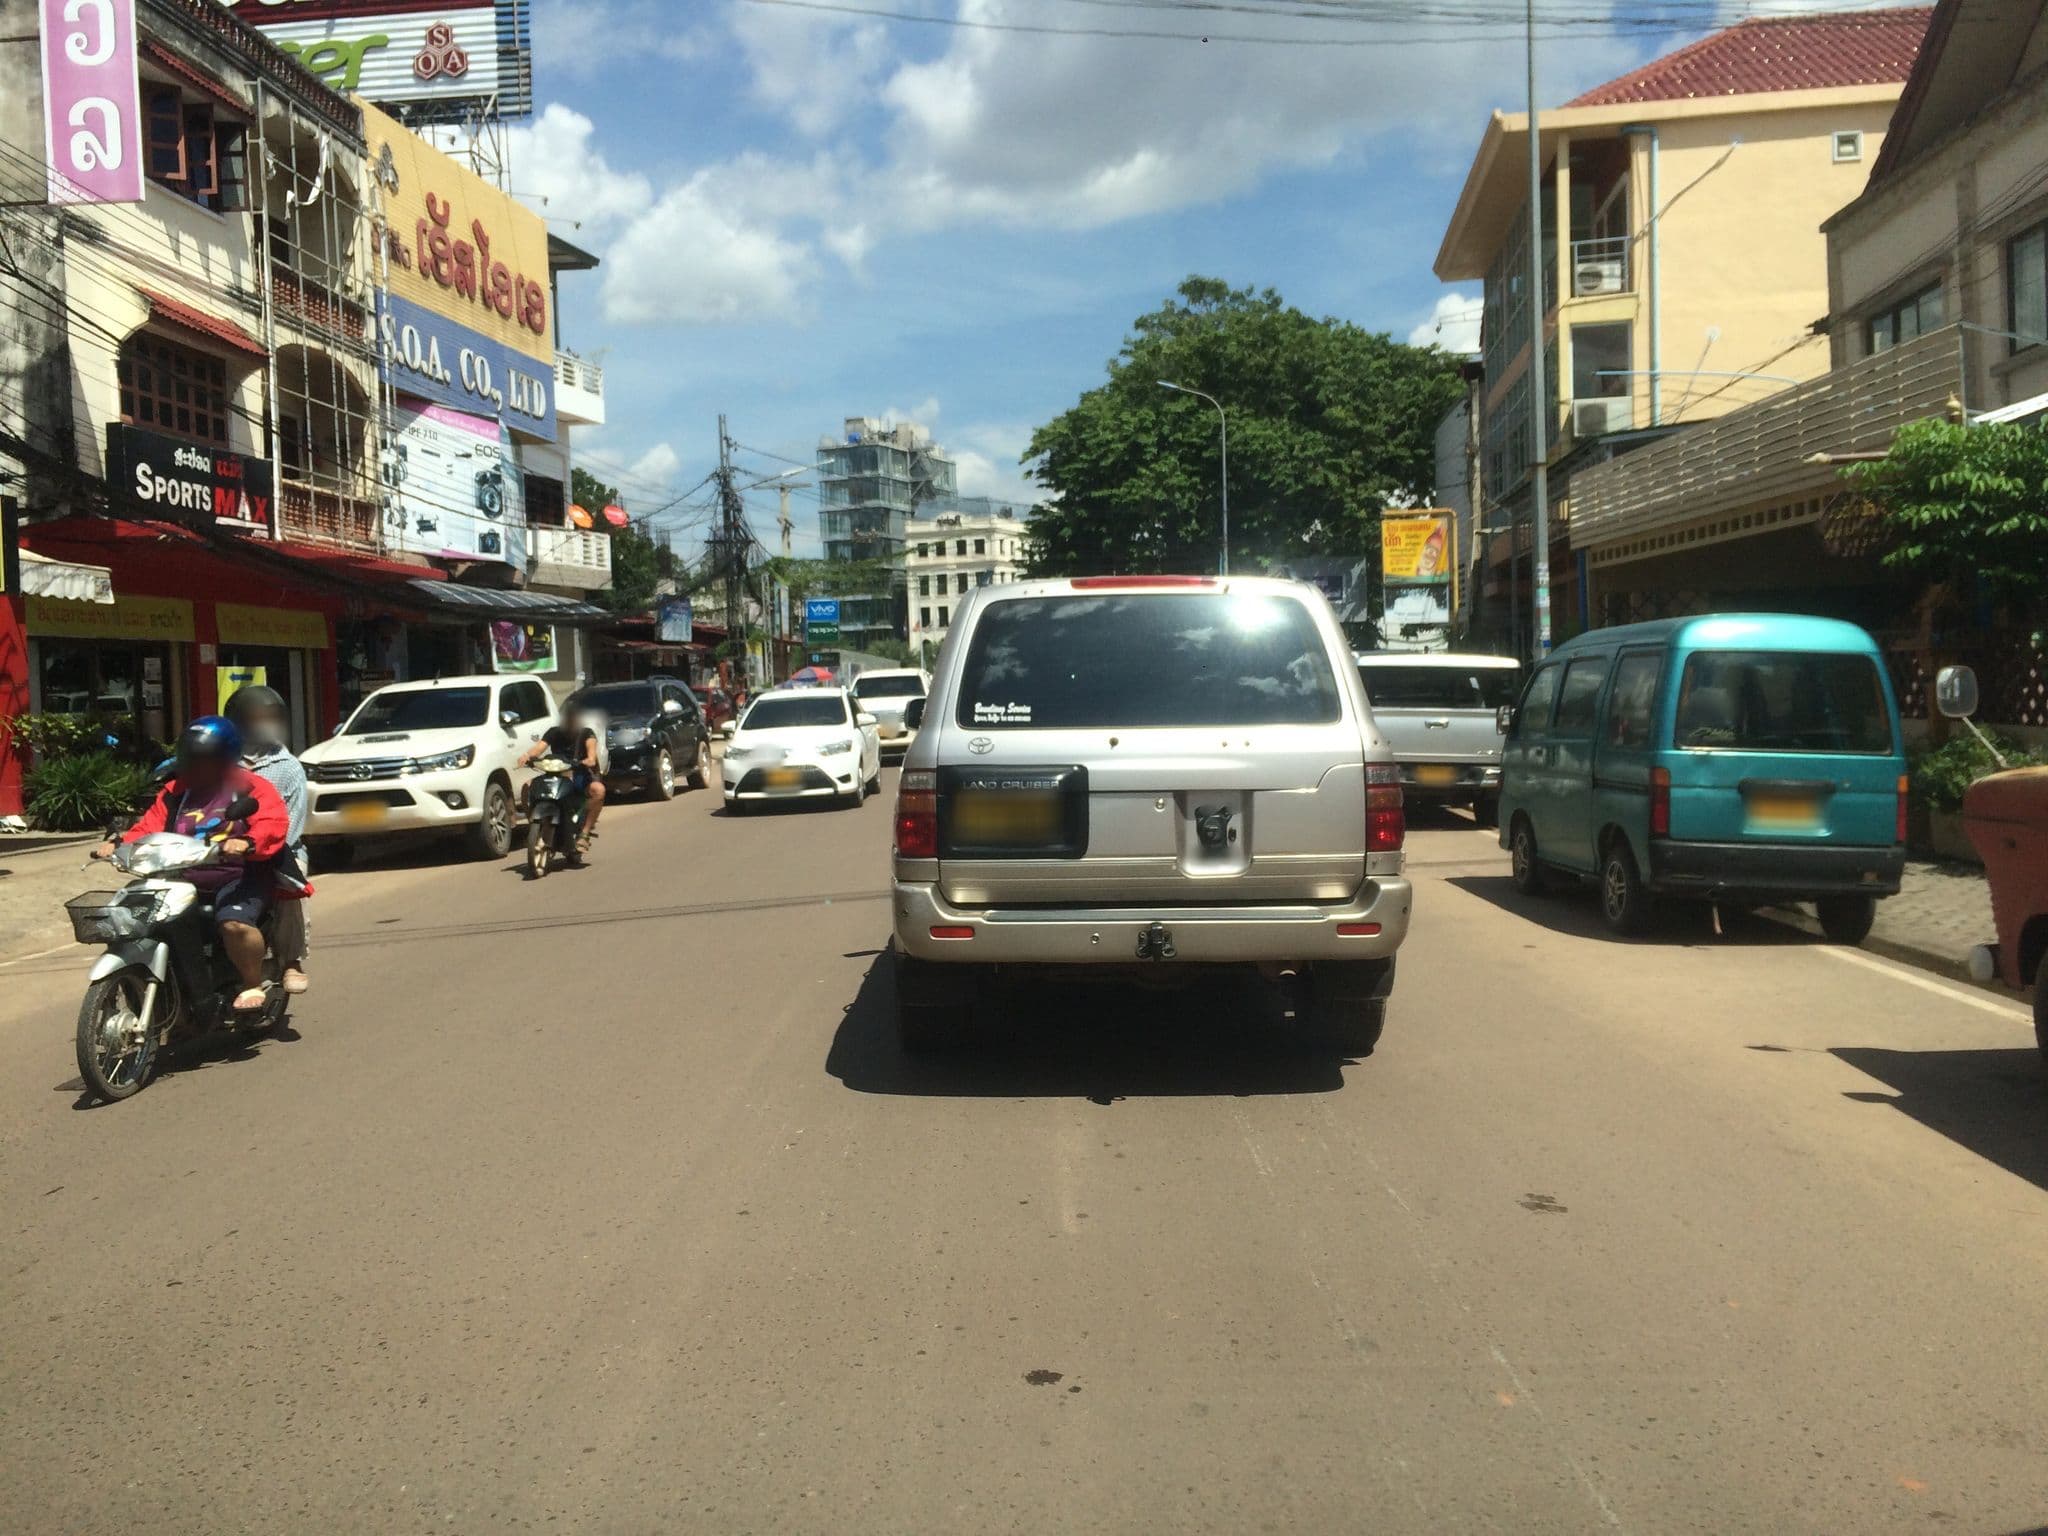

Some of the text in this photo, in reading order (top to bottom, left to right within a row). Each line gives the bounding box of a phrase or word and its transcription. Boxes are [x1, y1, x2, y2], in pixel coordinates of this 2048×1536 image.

[508, 368, 546, 418] LTD
[474, 443, 501, 460] EOS
[214, 485, 268, 525] MAX
[962, 780, 1060, 790] LAND CRUISER
